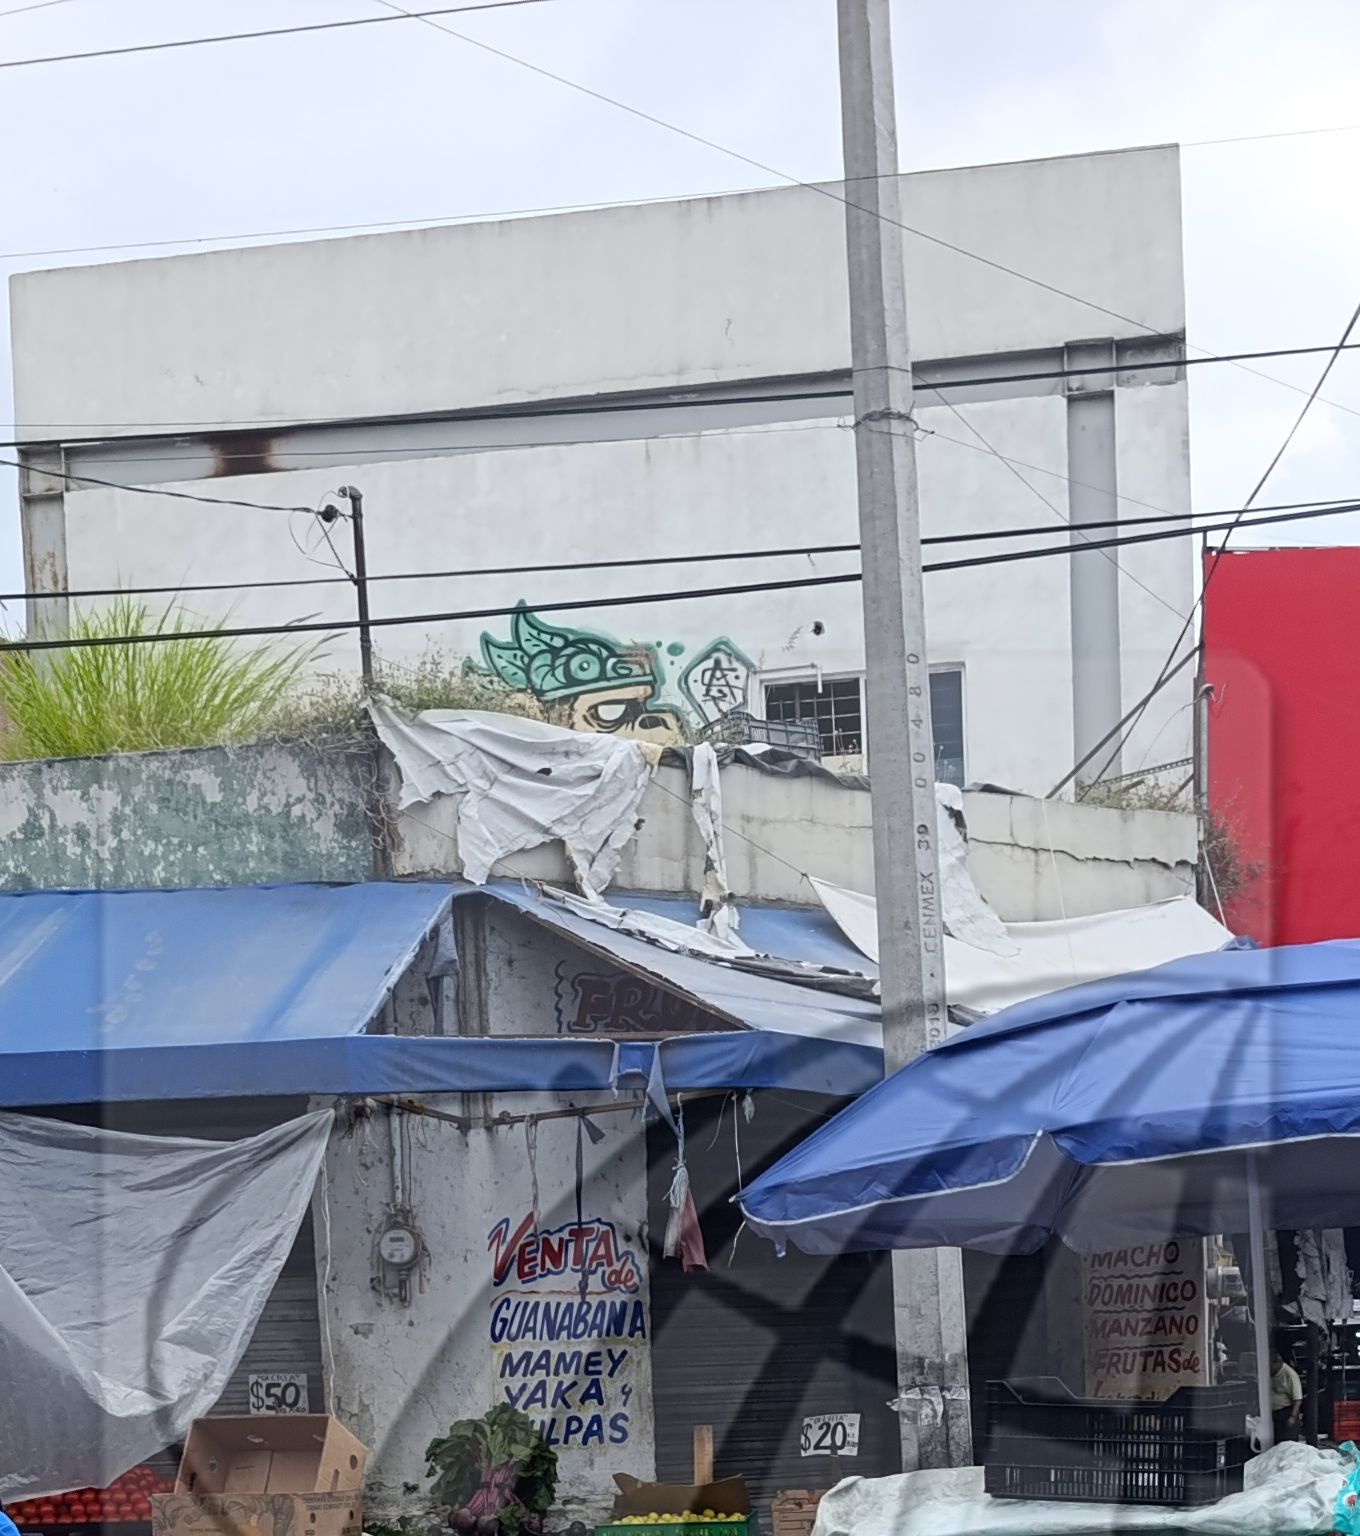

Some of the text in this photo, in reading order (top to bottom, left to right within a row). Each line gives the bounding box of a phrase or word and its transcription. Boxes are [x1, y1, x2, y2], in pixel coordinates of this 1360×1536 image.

[487, 1212, 642, 1293] VENTA de
[1089, 1241, 1180, 1269] MACHO
[1087, 1279, 1197, 1307] DOMINICO
[490, 1297, 646, 1344] GUANABANA
[1088, 1315, 1199, 1339] MANZANO
[499, 1348, 628, 1379] MAMEY
[1092, 1348, 1182, 1376] FRUTAS
[250, 1379, 301, 1412] $50
[800, 1421, 848, 1454] $20
